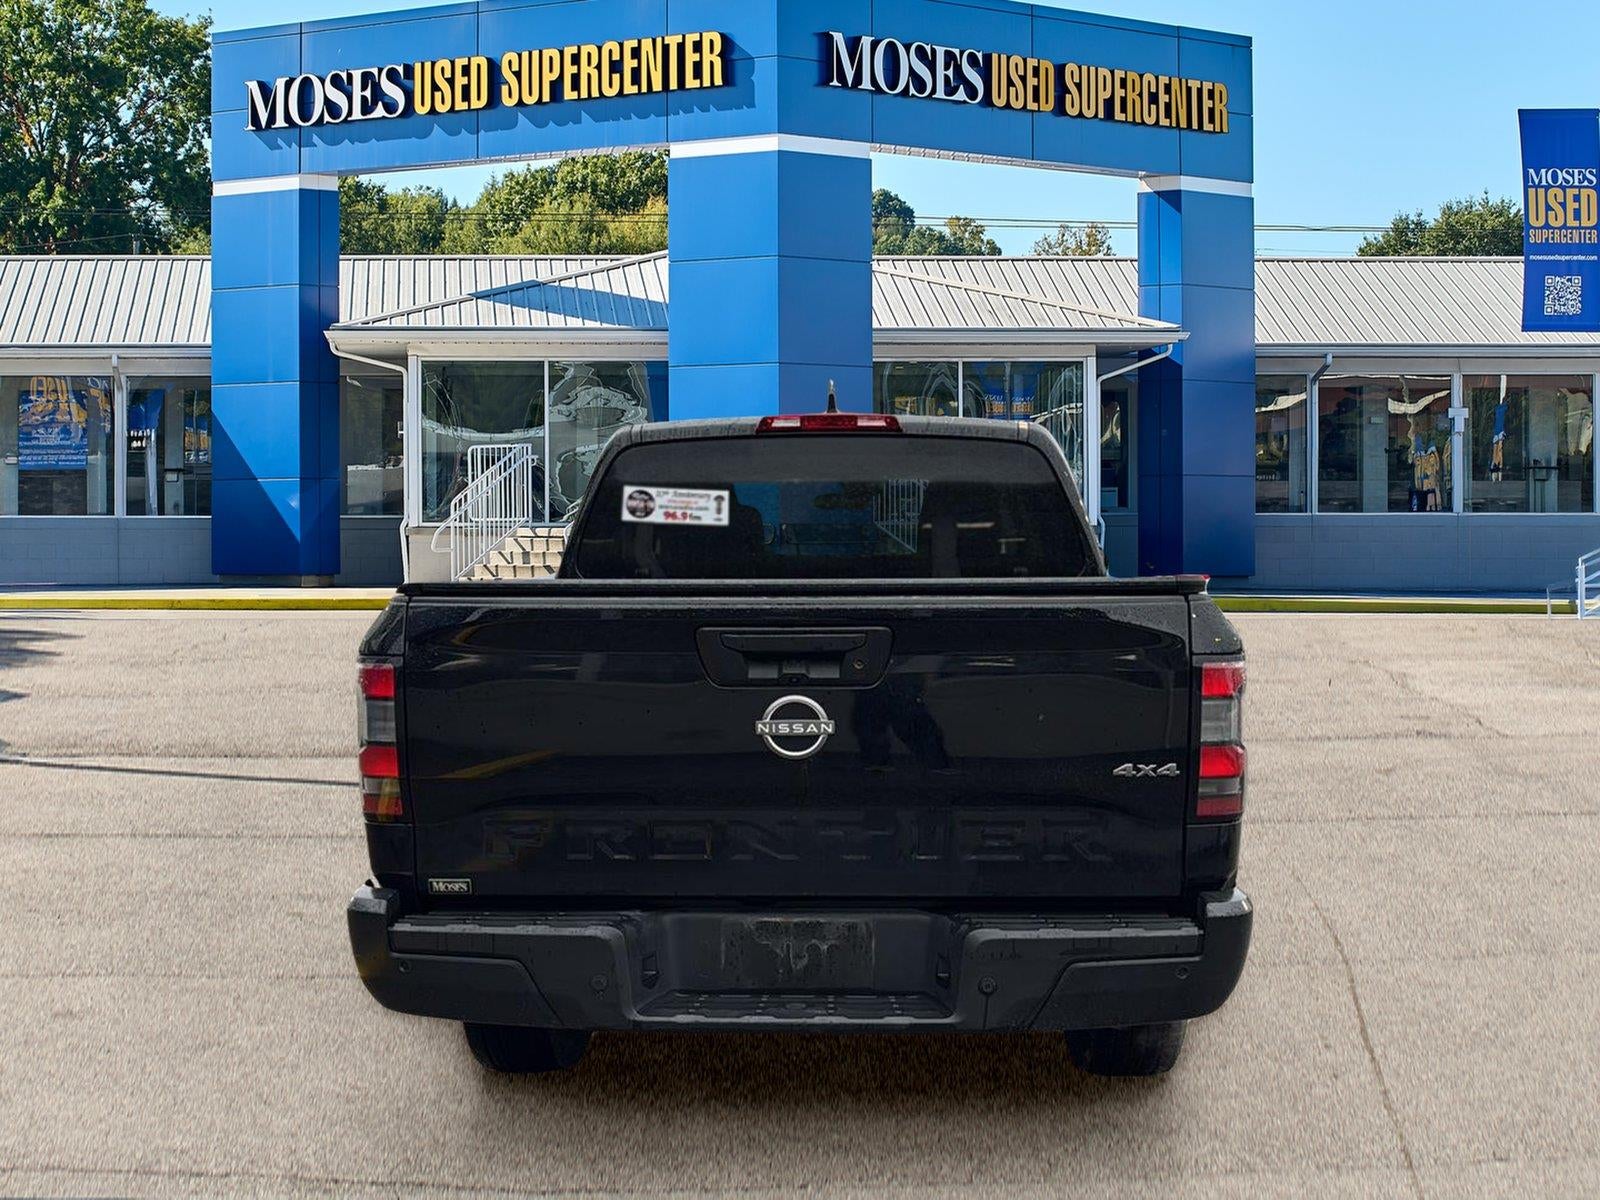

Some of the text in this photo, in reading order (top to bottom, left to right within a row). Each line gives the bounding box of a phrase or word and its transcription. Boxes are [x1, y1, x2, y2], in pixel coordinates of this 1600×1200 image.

[244, 31, 723, 131] MOSES USED SUPERCENTER
[829, 31, 1229, 133] MOSES USED SUPERCENTER
[1527, 168, 1597, 186] MOSES
[1527, 187, 1598, 227] USED
[1529, 229, 1598, 244] SUPERCENTER
[663, 511, 688, 521] 96.9
[757, 723, 833, 733] NISSAN
